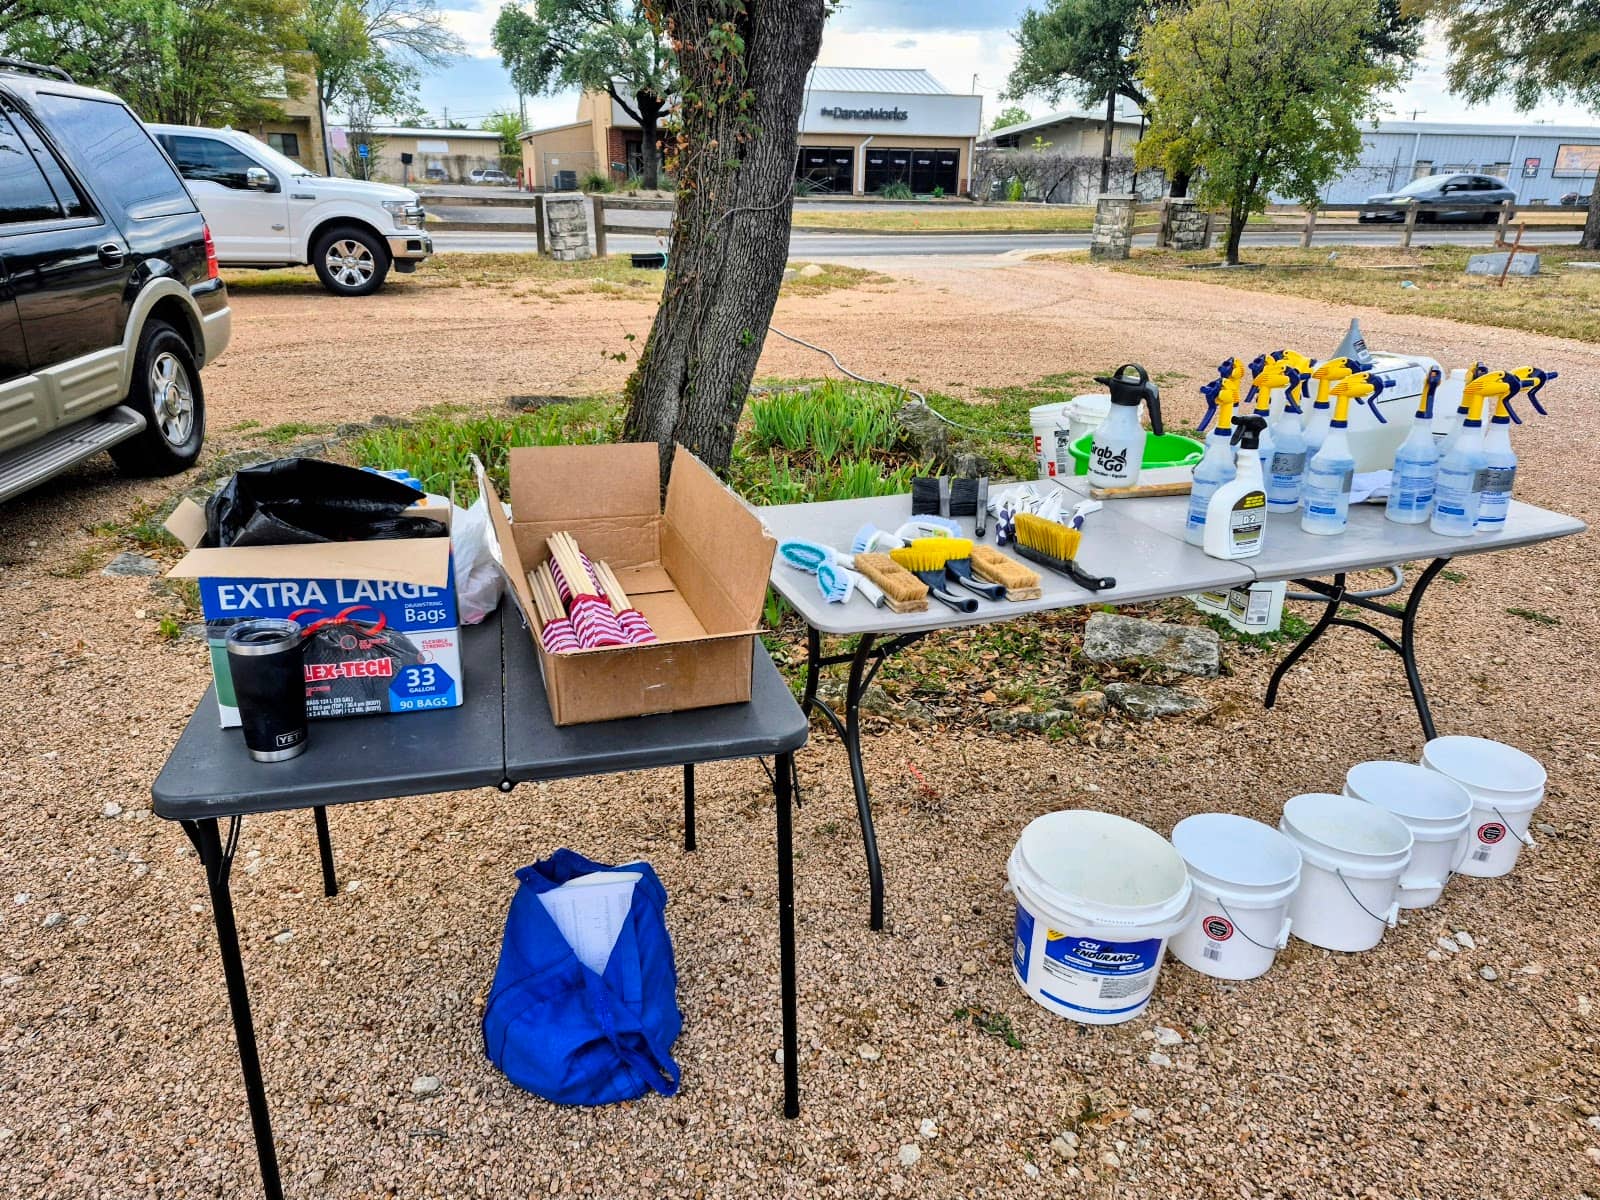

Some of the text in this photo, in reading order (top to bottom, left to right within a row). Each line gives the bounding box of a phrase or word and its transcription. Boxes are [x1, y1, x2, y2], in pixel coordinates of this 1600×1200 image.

[217, 579, 439, 610] EXTRA LARGE
[404, 600, 444, 608] DRAWSTRING
[405, 608, 447, 624] Bags
[304, 657, 393, 682] LEX-TECH
[406, 667, 436, 687] 33
[409, 686, 436, 694] GALLON
[400, 698, 448, 709] 90 BAGS
[279, 734, 299, 744] YET
[1078, 941, 1101, 950] CCH
[1073, 947, 1140, 963] ENDURANCE
